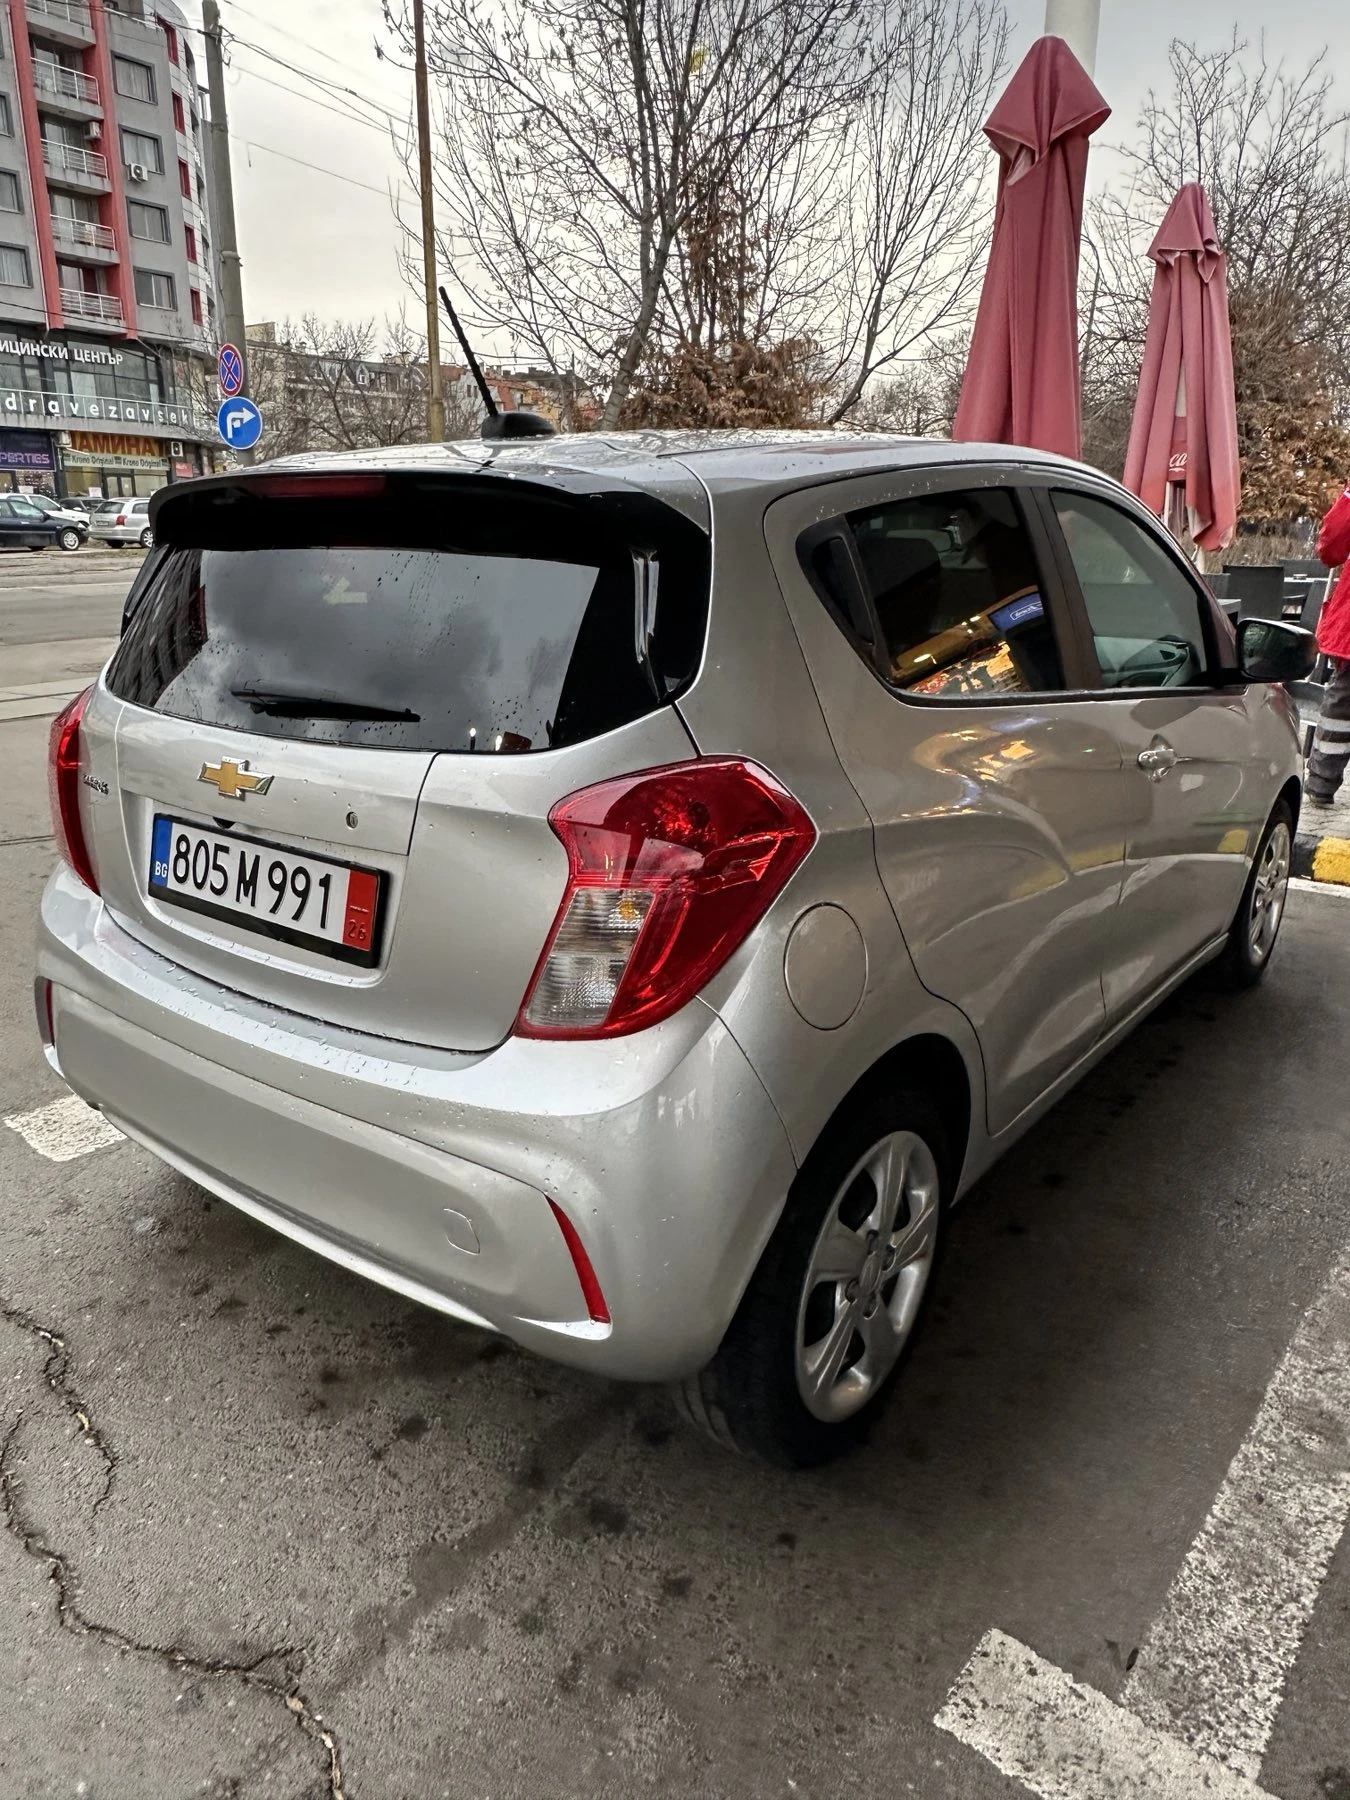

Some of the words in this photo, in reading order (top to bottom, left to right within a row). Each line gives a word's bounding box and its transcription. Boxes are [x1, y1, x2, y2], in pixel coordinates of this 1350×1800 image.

[74, 348, 123, 365] ЦЕНТЪР
[155, 860, 168, 878] BG
[172, 833, 231, 897] 805
[235, 850, 261, 908] M
[267, 860, 333, 930] 991
